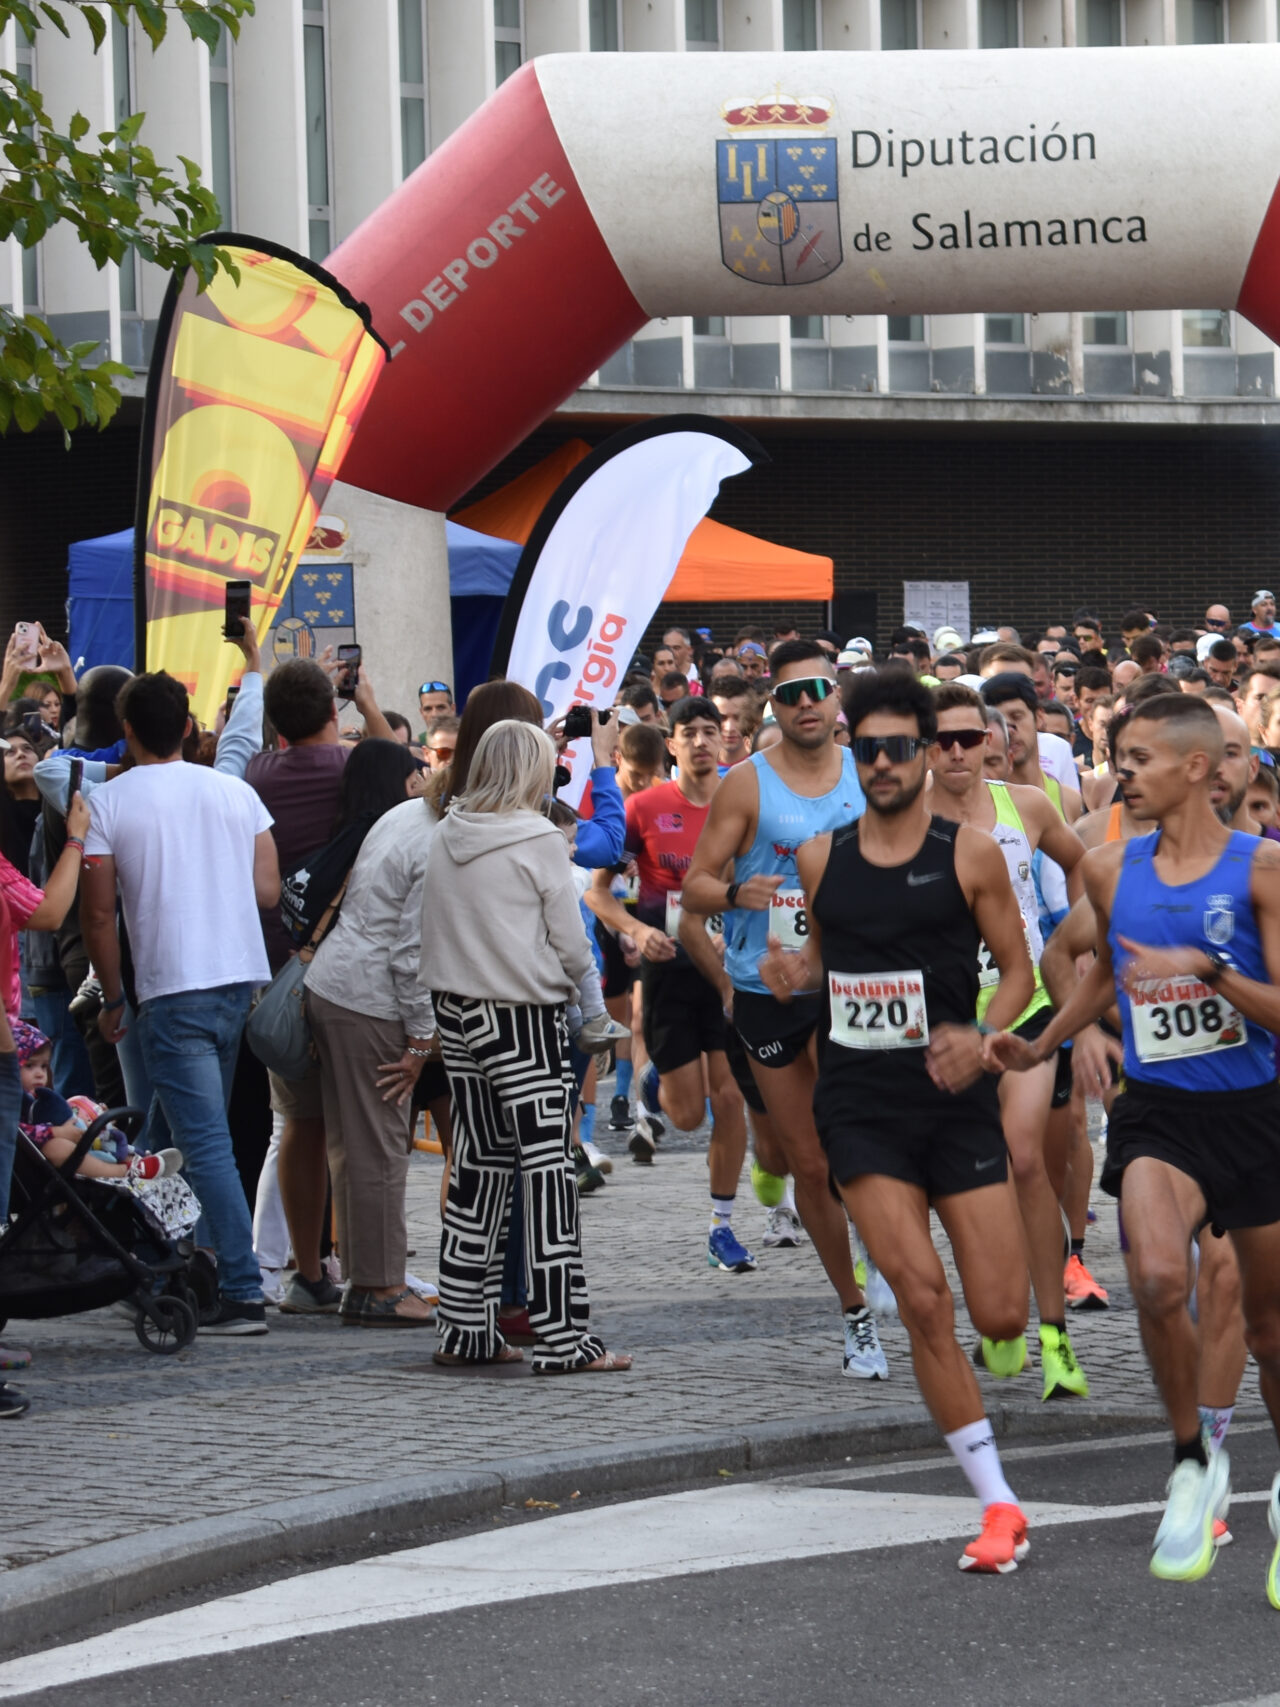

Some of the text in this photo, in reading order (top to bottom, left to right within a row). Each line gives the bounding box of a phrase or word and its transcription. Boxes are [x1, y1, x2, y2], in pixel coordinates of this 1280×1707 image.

[851, 122, 1097, 177] Diputación
[853, 210, 1148, 252] de Salamanca
[399, 172, 566, 333] DEPORTE
[155, 508, 274, 576] GADIS
[832, 977, 921, 997] bedunia
[845, 999, 908, 1029] 220
[1152, 998, 1223, 1040] 308
